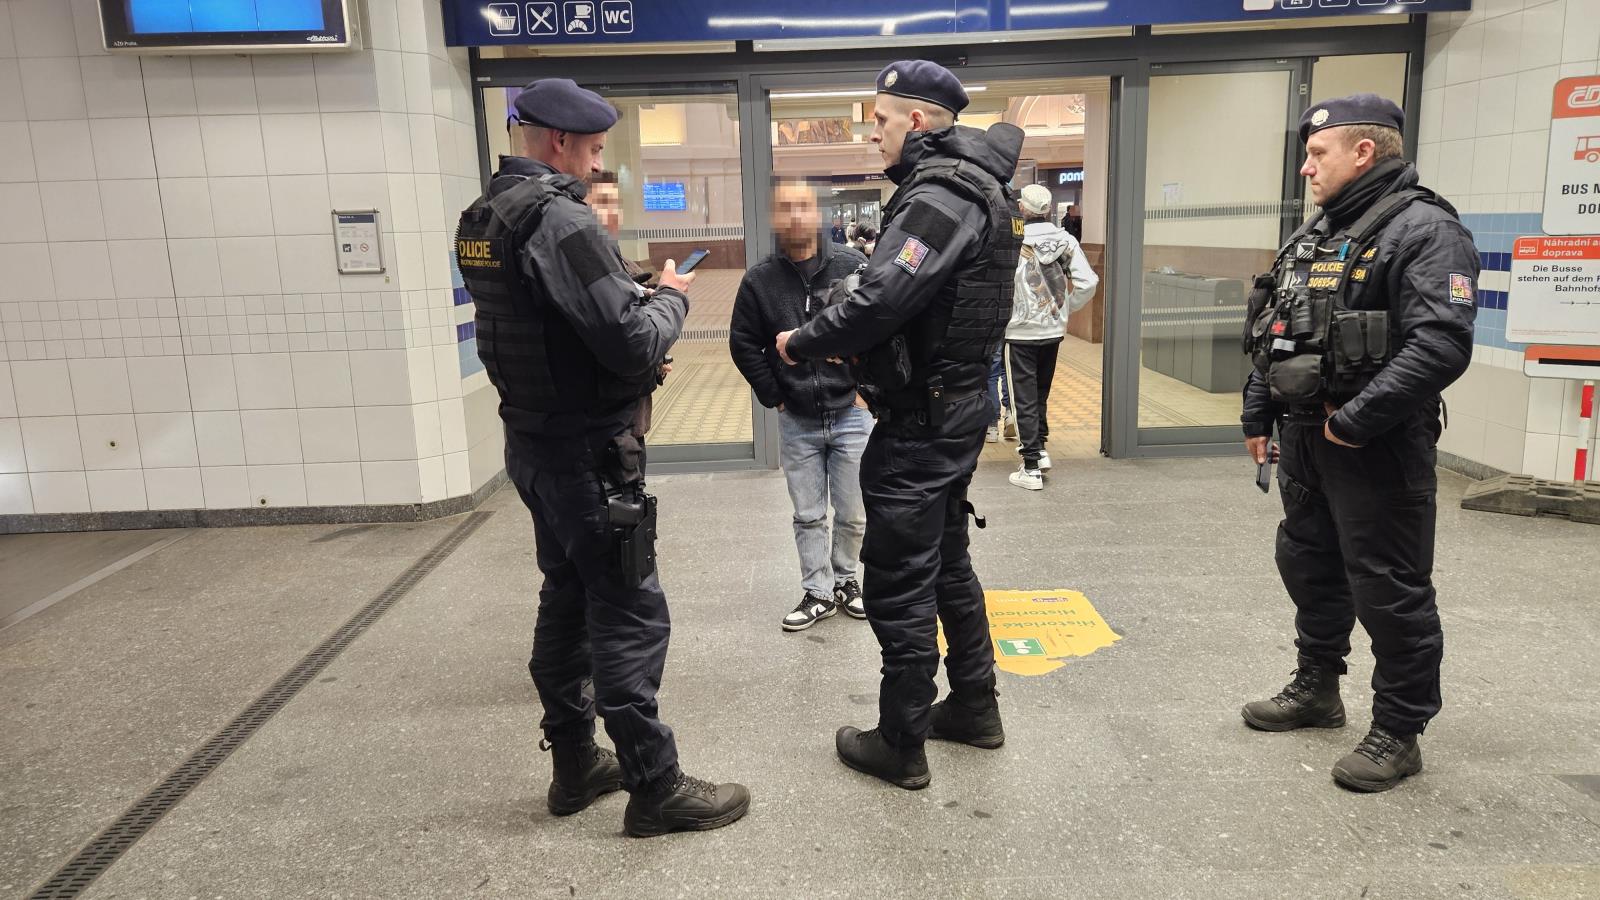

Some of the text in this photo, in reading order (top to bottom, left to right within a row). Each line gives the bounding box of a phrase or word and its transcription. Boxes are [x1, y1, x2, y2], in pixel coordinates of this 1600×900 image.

[604, 10, 630, 24] WC
[1562, 183, 1588, 195] BUS
[1543, 238, 1591, 247] Náhradní
[459, 240, 491, 258] OLICIE
[1542, 248, 1583, 258] doprava
[1311, 262, 1345, 273] POLICIE
[1532, 264, 1583, 273] Die Busse
[1517, 274, 1551, 283] stehen
[1553, 274, 1569, 283] auf
[1571, 274, 1594, 283] dem
